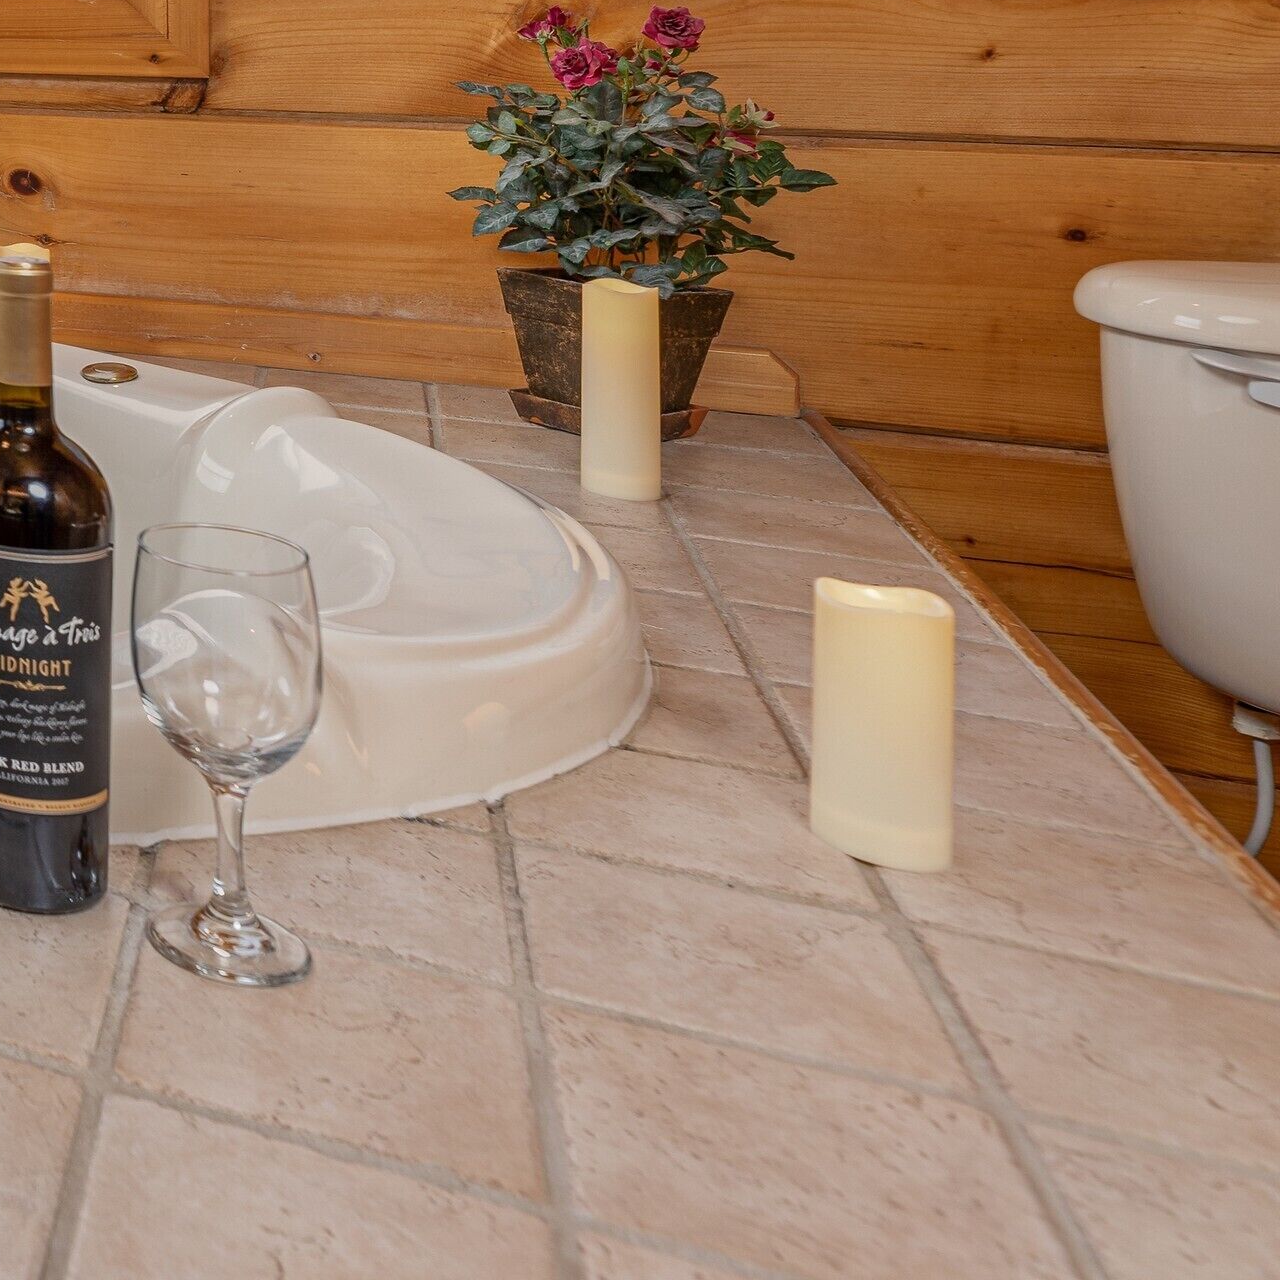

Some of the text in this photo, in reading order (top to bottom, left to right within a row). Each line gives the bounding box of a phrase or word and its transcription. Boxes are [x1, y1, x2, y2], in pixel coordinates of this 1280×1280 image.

[42, 624, 59, 646] à
[58, 616, 100, 646] Trois
[11, 758, 40, 773] RED
[43, 761, 85, 774] BLEND
